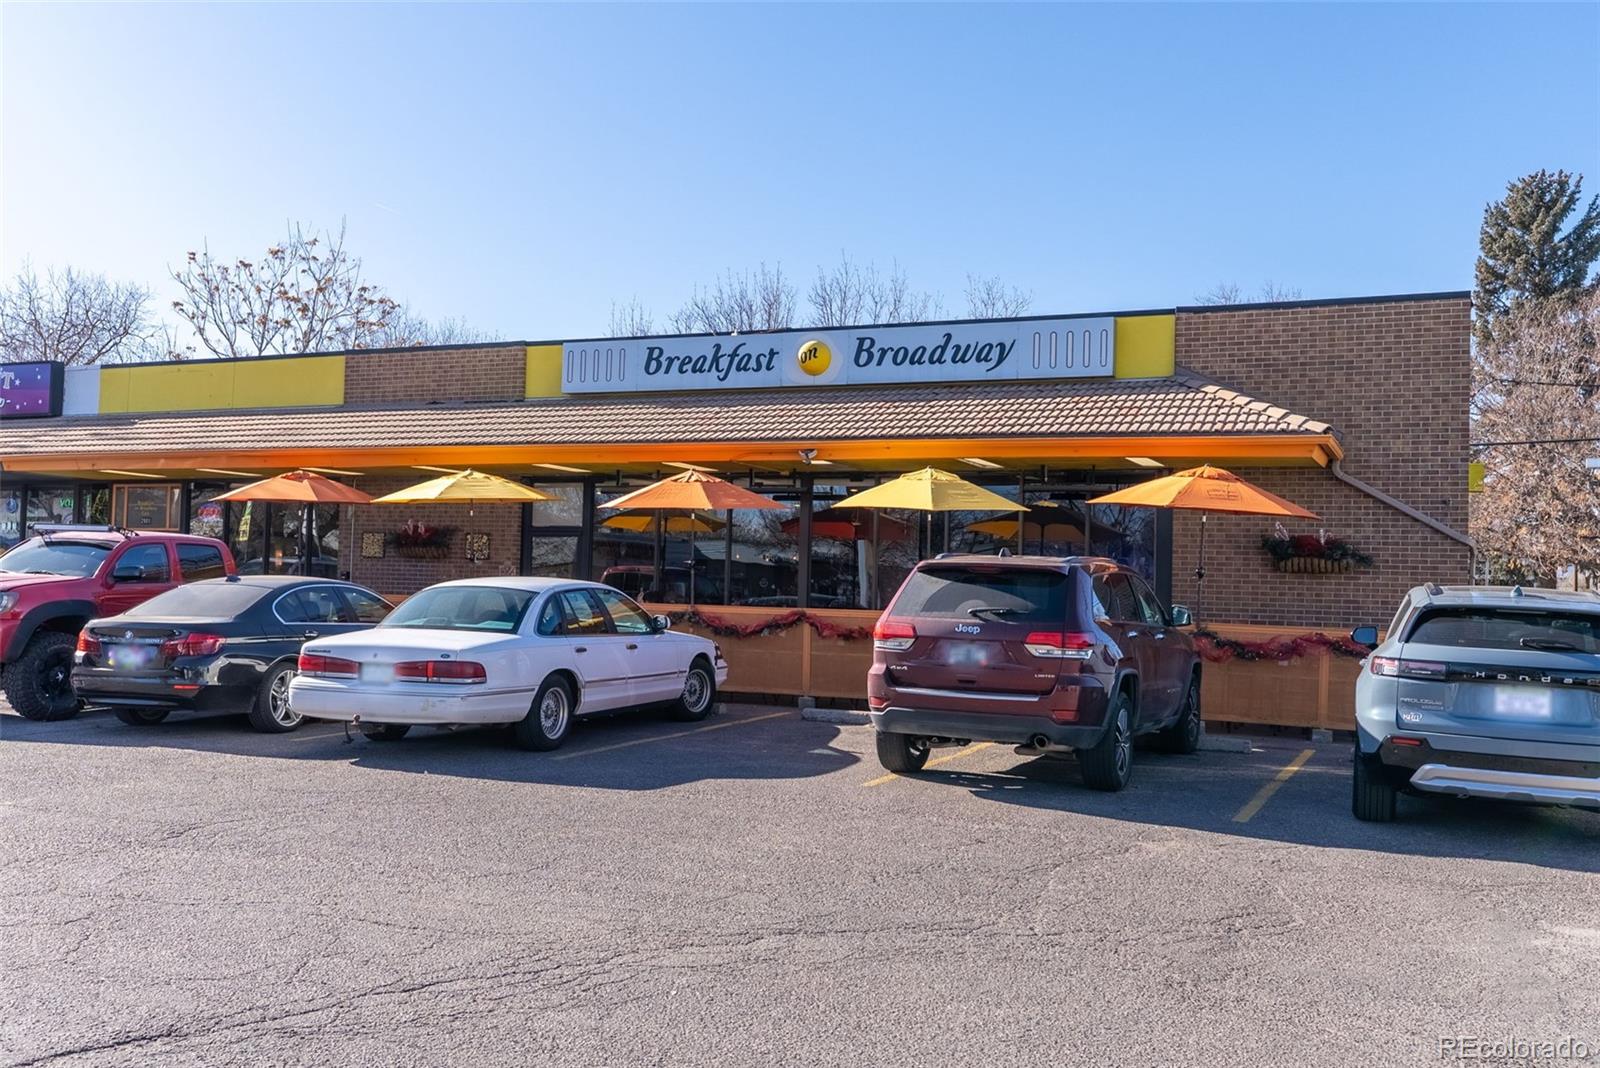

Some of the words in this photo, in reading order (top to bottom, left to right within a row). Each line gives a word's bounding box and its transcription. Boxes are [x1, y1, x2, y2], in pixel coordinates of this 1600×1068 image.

[644, 342, 779, 382] Breakfast
[800, 347, 818, 364] on
[853, 333, 1016, 372] Broadway
[955, 624, 981, 634] Jeep
